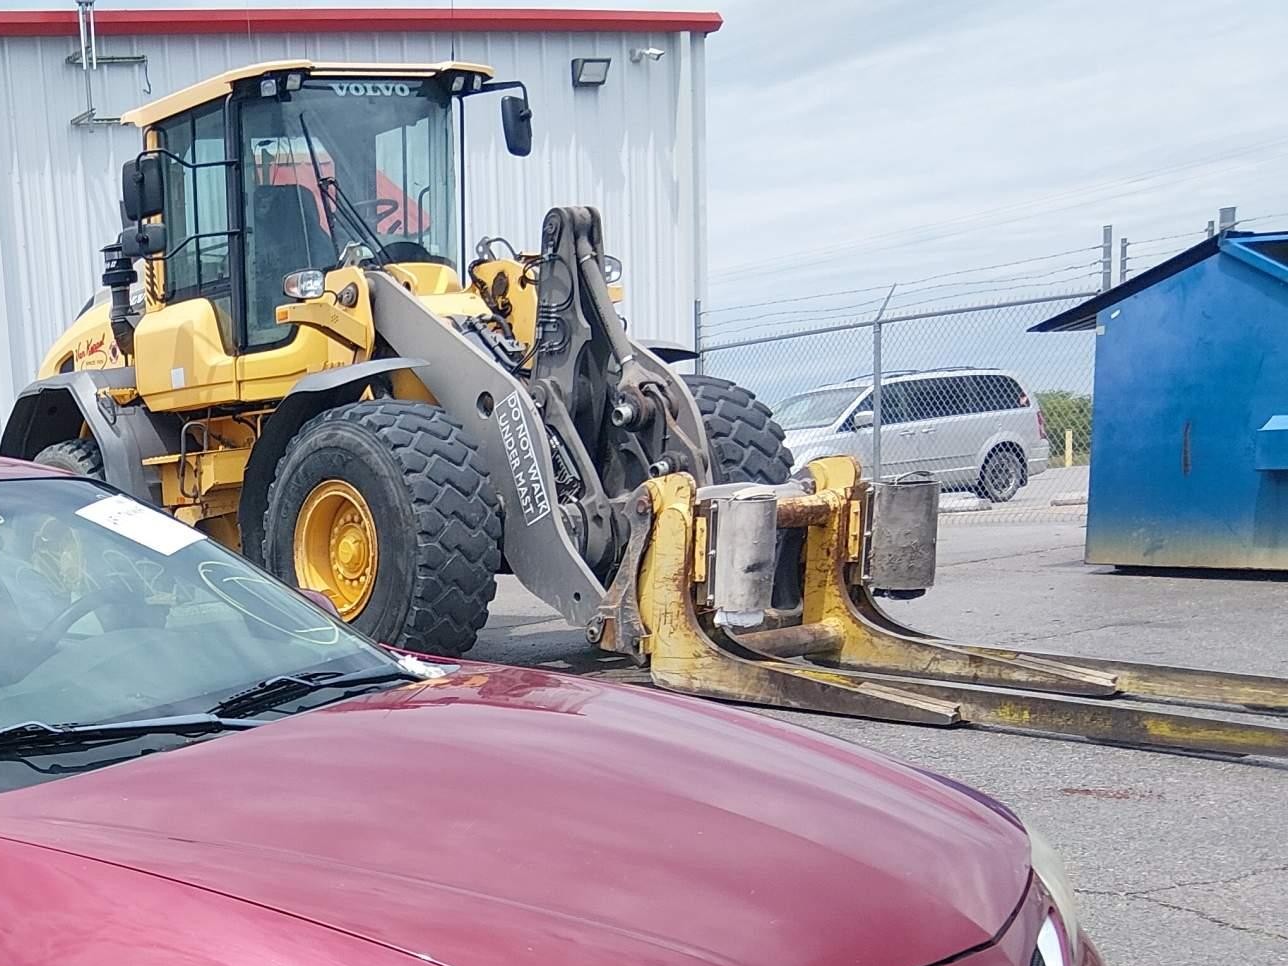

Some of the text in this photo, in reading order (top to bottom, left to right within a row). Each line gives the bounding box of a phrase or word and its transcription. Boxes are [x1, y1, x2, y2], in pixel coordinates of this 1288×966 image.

[329, 83, 410, 97] VOLVO
[499, 412, 535, 515] UNDER MAST
[507, 395, 549, 514] DO NOT WALK
